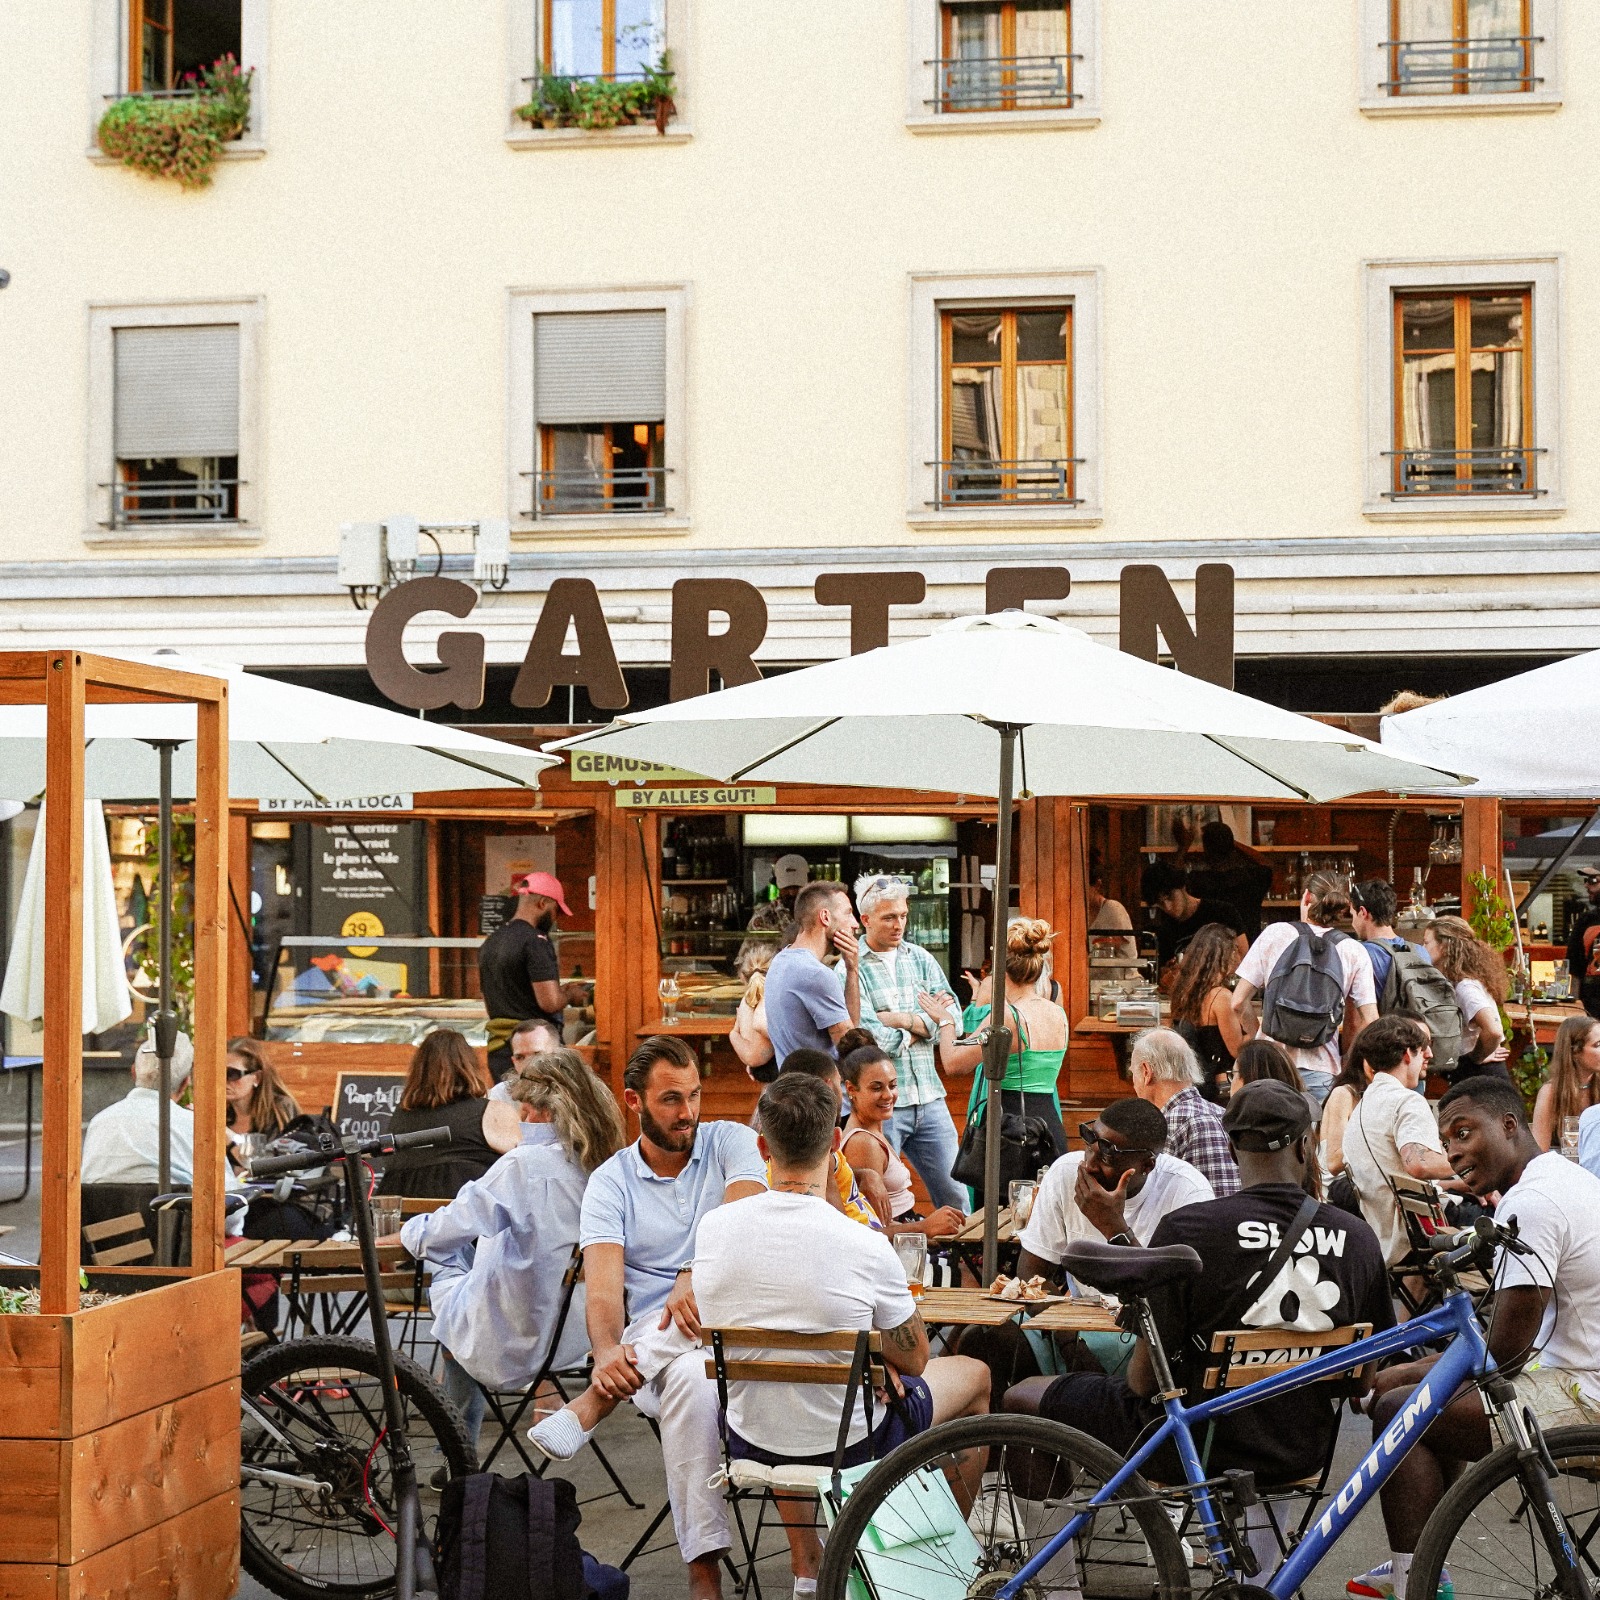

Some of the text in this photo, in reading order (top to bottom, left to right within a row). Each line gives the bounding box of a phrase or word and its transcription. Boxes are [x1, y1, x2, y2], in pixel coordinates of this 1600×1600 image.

[269, 799, 287, 808] BY
[359, 795, 403, 808] LOCA
[632, 788, 756, 805] BY ALLES GUT!
[349, 867, 384, 879] Suiss
[1314, 1383, 1432, 1538] TOTEM
